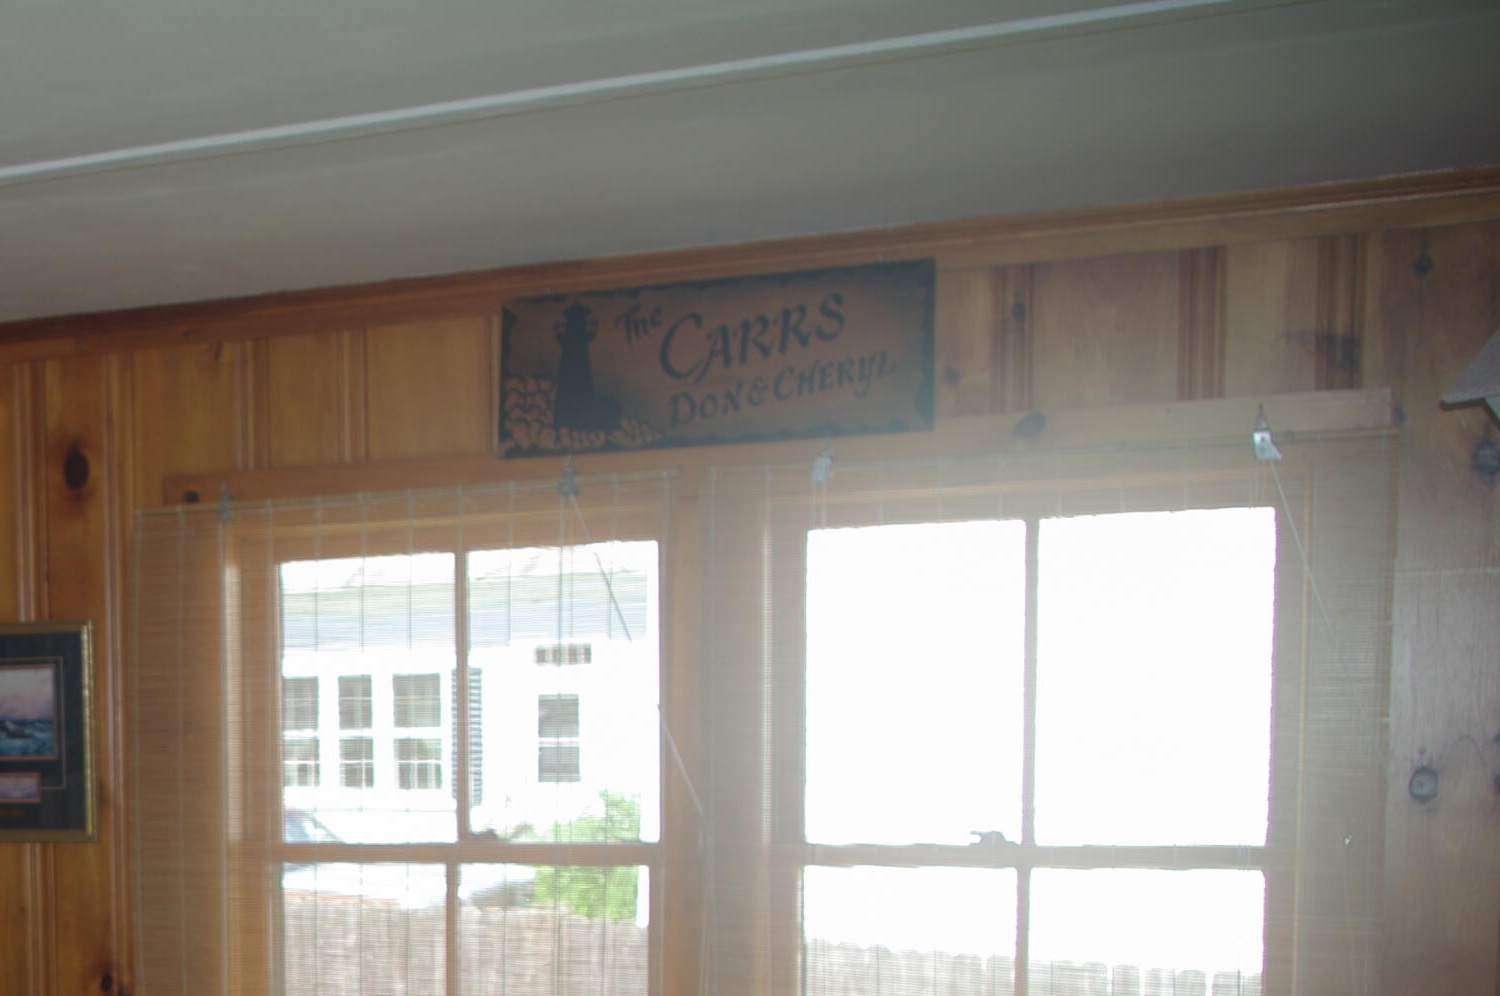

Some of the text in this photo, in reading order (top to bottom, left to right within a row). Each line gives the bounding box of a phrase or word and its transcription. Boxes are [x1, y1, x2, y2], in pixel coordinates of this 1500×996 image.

[614, 291, 846, 384] The CARRS
[668, 381, 743, 428] DON
[773, 349, 898, 401] CHERYL
